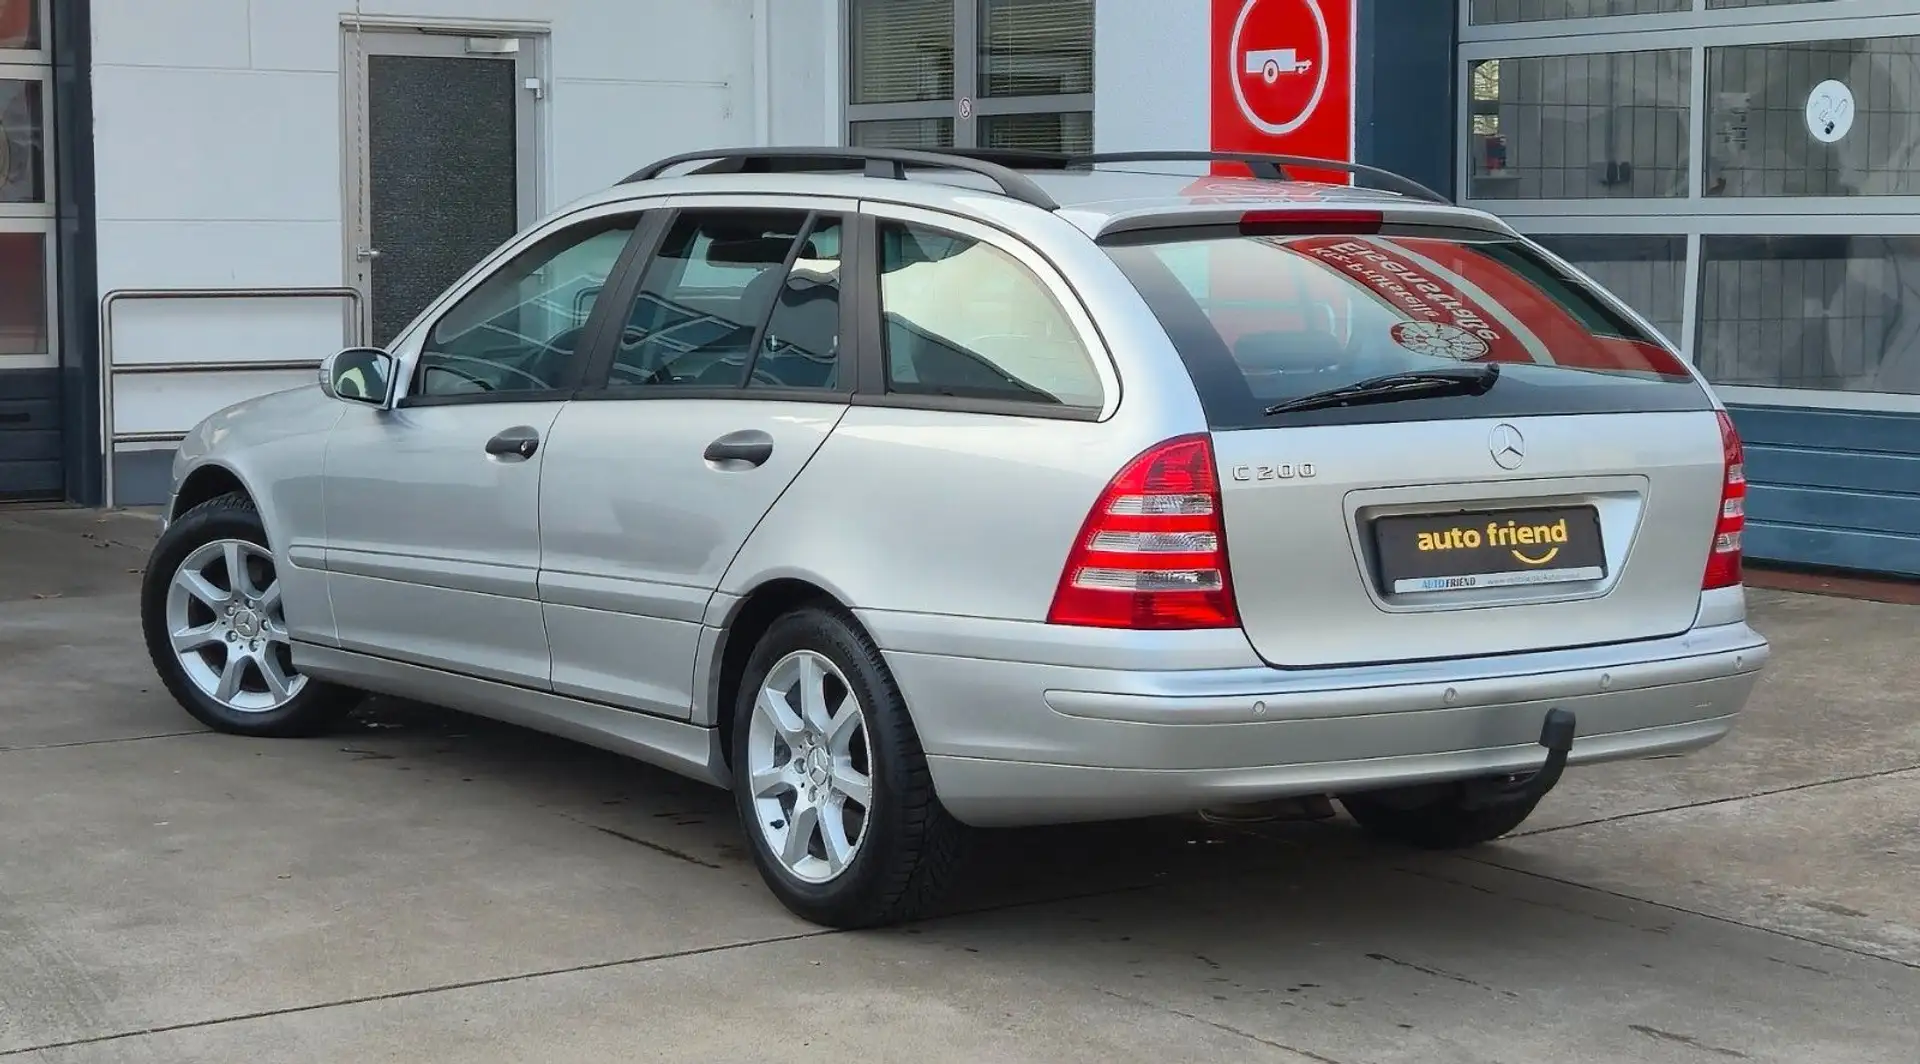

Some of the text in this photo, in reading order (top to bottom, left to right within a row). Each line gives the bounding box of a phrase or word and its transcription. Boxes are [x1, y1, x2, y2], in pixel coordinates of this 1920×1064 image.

[1232, 462, 1317, 481] C 200
[1417, 518, 1568, 551] auto friend
